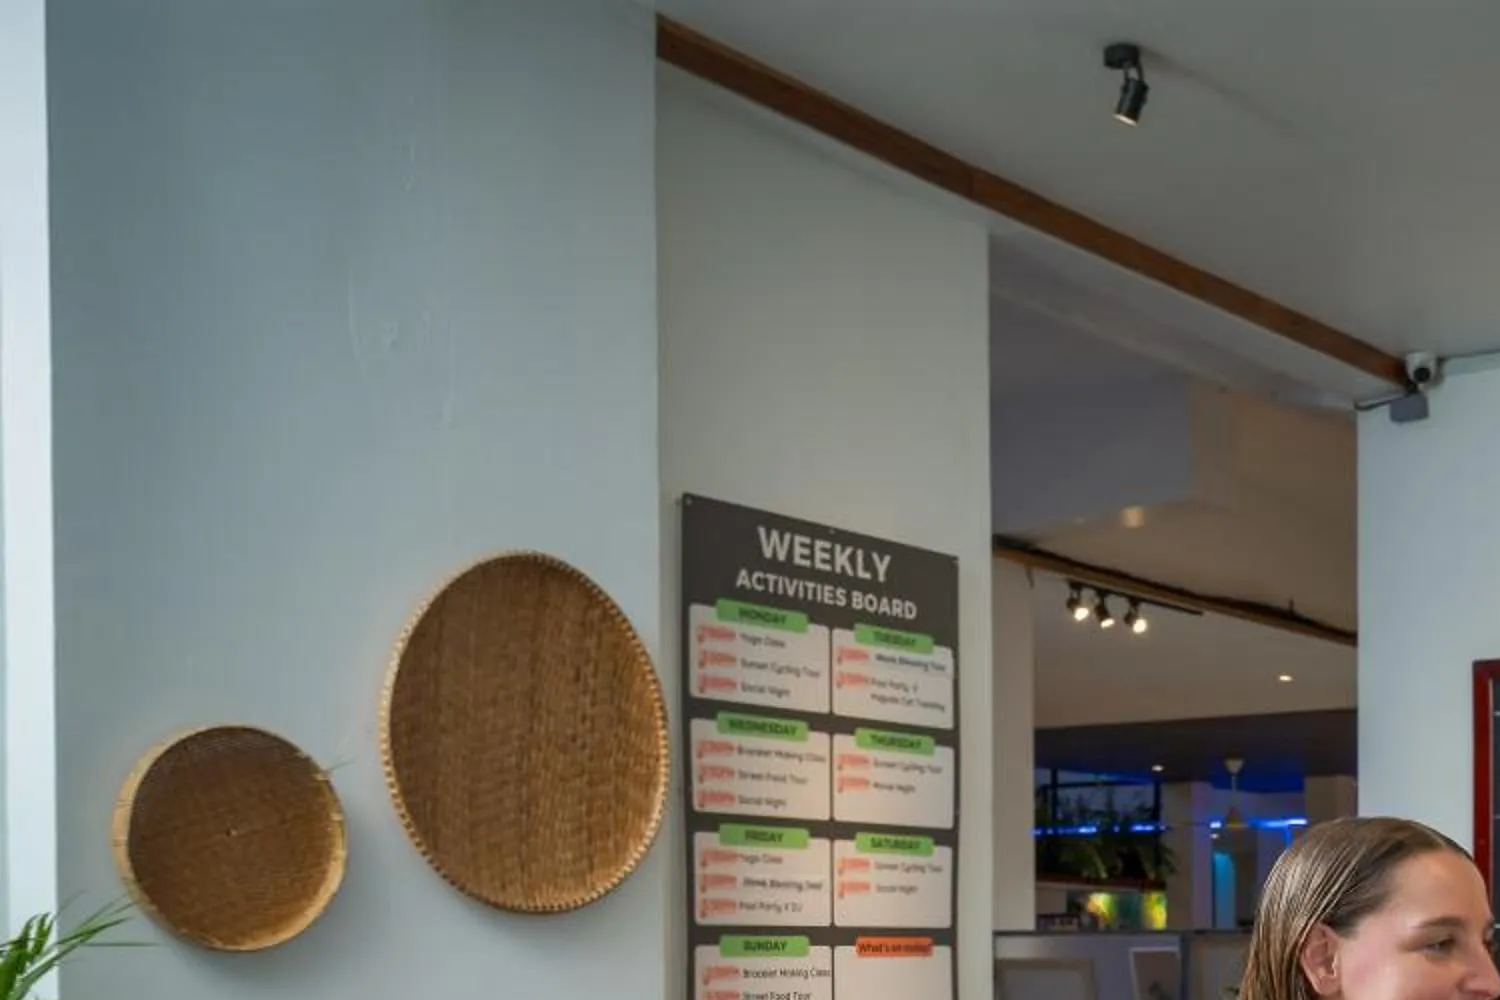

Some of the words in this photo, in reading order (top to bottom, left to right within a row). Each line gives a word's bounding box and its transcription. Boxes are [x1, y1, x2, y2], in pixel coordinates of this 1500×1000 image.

[757, 525, 892, 583] WEEKLY
[736, 569, 847, 607] ACTIVITIES
[852, 590, 917, 620] BOARD
